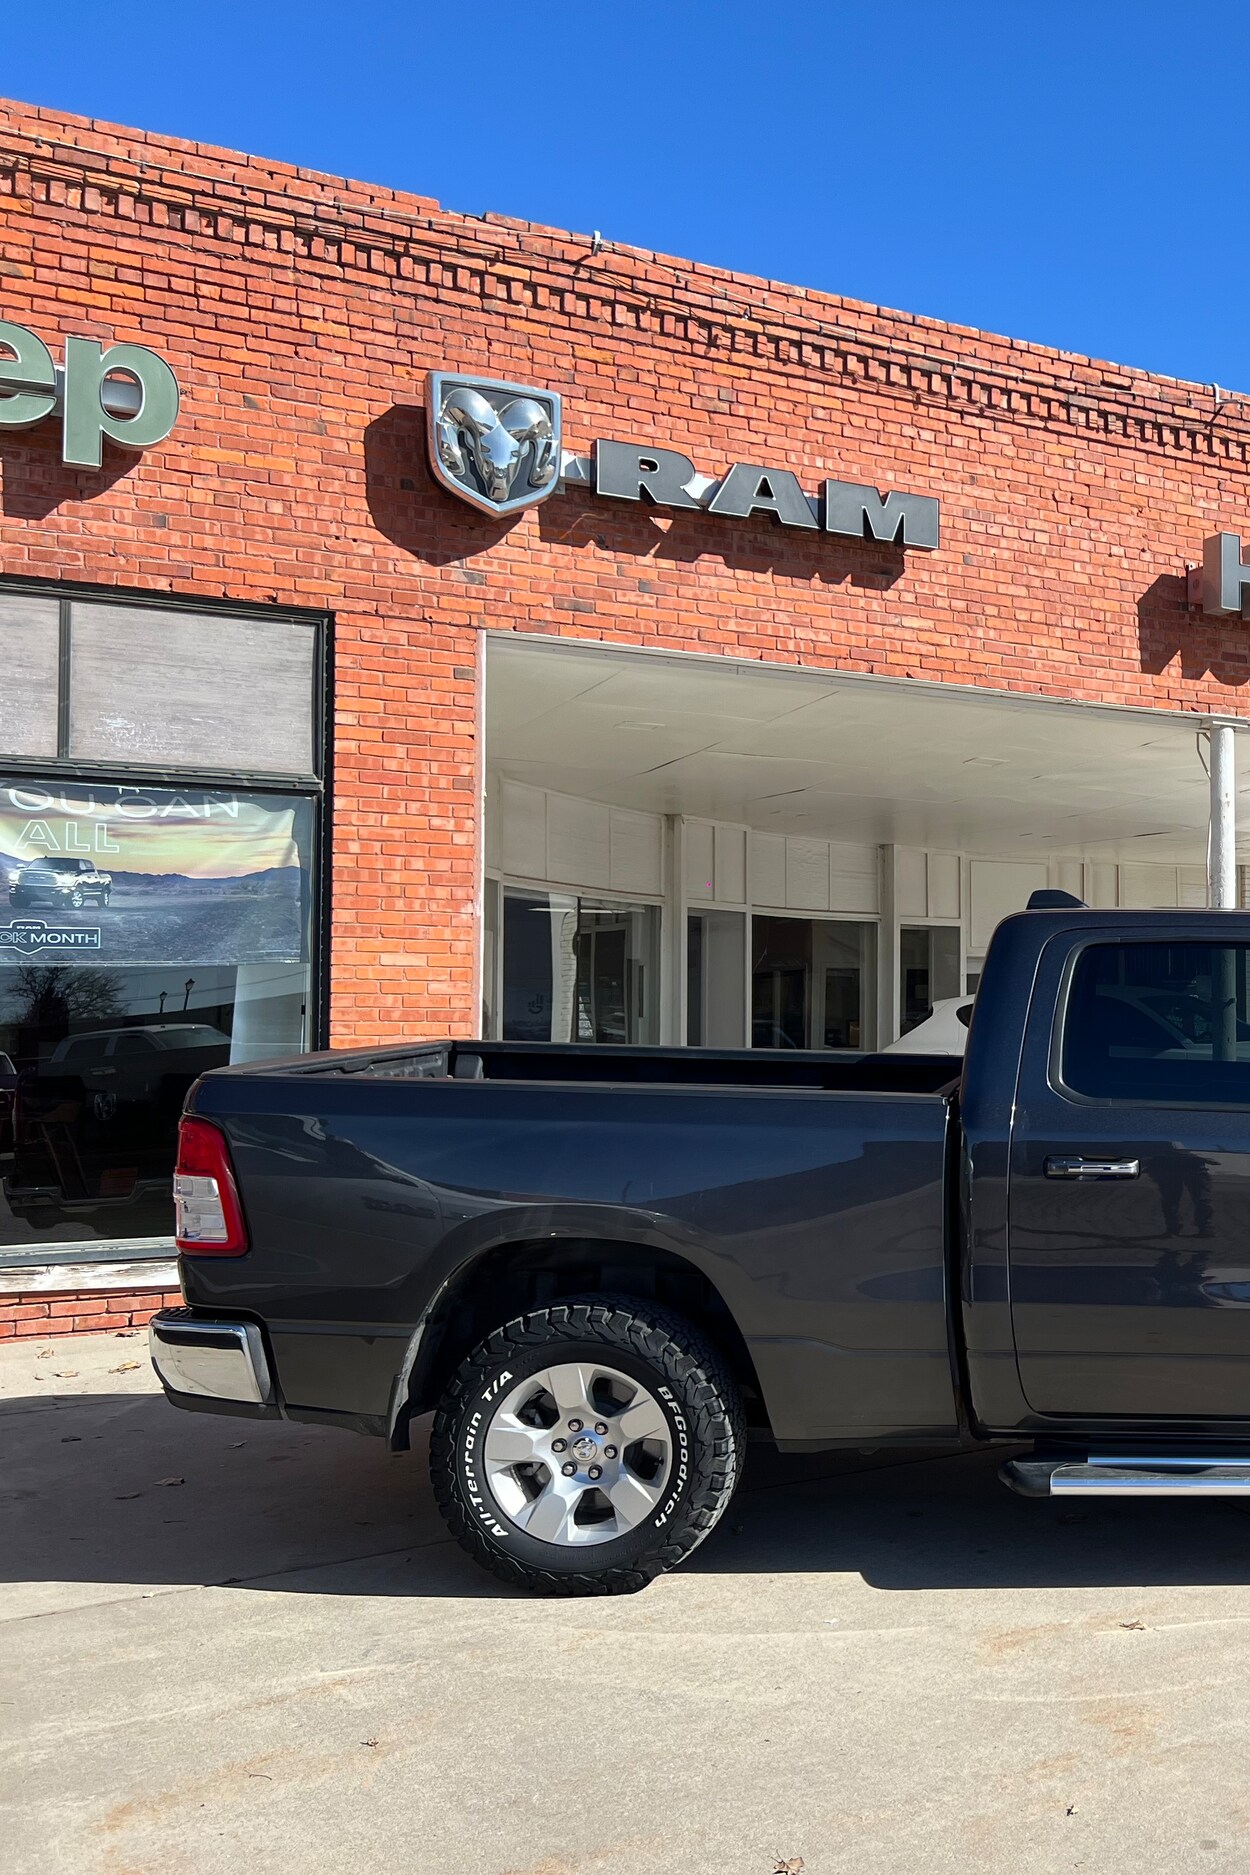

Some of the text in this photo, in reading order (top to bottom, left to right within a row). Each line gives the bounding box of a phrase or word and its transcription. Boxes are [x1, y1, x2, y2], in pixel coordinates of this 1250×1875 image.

[595, 438, 940, 550] RAM
[0, 781, 240, 818] OU CAN
[14, 819, 120, 853] ALL
[30, 932, 98, 945] MONTH
[463, 1370, 514, 1538] All-Terrain T/A
[654, 1385, 689, 1528] BFGoodrich
